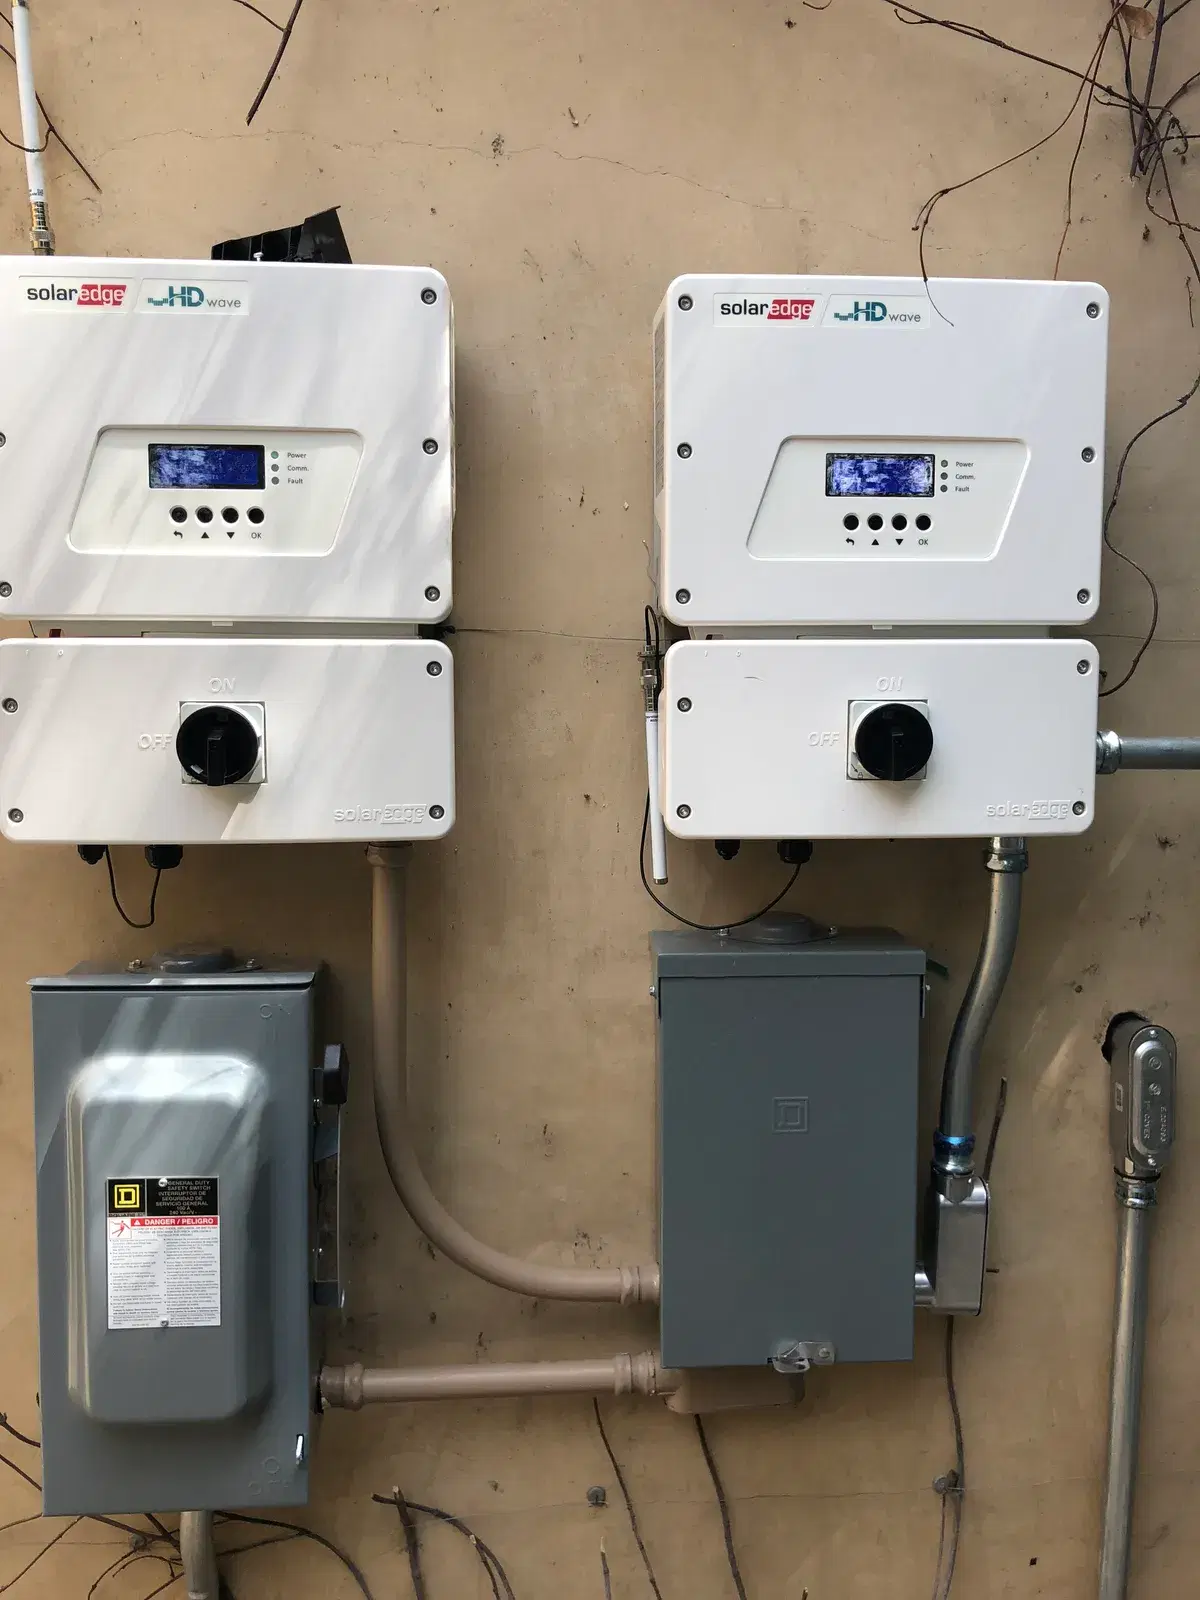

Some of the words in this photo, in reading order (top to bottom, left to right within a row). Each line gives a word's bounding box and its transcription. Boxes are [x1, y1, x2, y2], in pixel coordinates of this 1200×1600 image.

[27, 284, 126, 306] solaredge
[168, 286, 204, 307] HD
[207, 297, 241, 309] wave
[720, 299, 814, 319] solaredge
[853, 301, 888, 322] HD
[889, 312, 921, 323] wave
[918, 538, 929, 546] OK
[208, 676, 235, 693] ON
[876, 676, 904, 692] ON
[138, 733, 172, 751] OFF
[807, 731, 840, 747] OFF
[181, 1217, 214, 1225] PELIGRO
